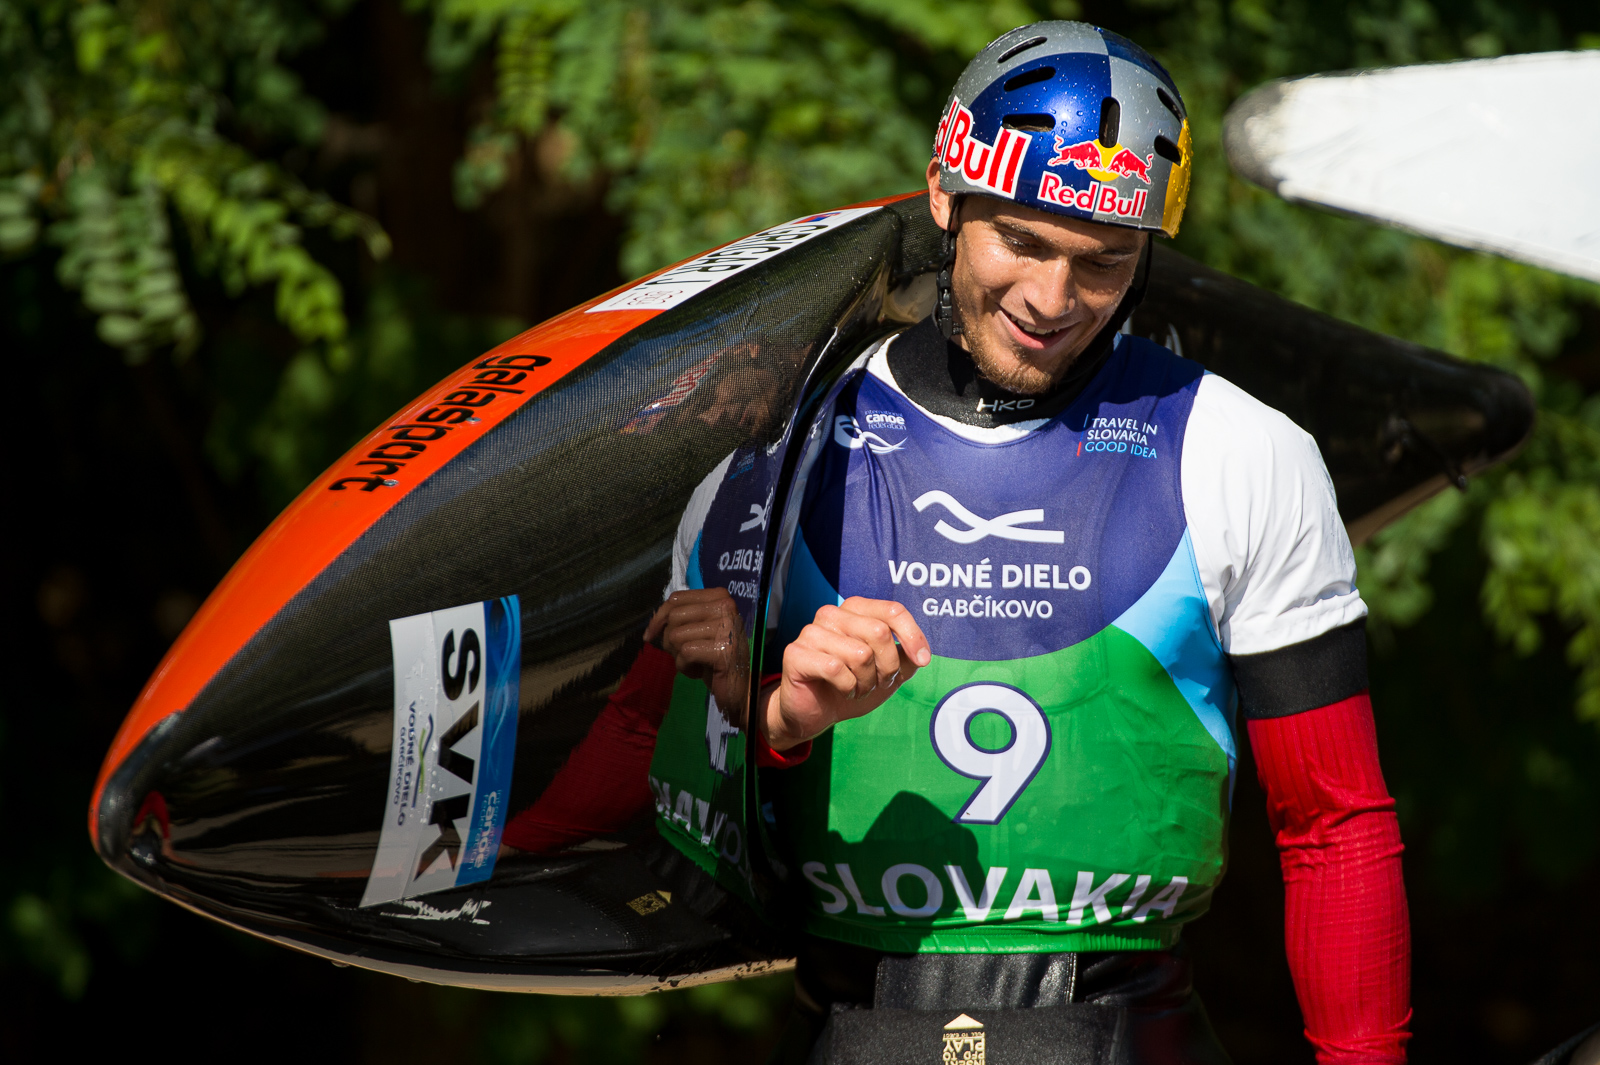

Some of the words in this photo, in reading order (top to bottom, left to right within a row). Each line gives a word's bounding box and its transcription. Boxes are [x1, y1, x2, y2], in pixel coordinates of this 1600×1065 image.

[944, 108, 1027, 195] Bull
[1039, 173, 1098, 210] Red
[1098, 187, 1148, 217] Bull
[662, 224, 829, 277] GRIGAR
[328, 354, 552, 492] galasport
[865, 413, 905, 425] canoe
[1086, 429, 1148, 445] SLOVAKIA
[1092, 417, 1138, 431] TRAVEL
[1142, 422, 1158, 435] IN
[1084, 440, 1128, 453] GOOD
[1130, 443, 1158, 459] IDEA
[888, 557, 993, 589] VODNÉ
[1001, 564, 1092, 591] DIELO
[922, 594, 1053, 619] GABČÍKOVO
[405, 700, 417, 766] VODNÉ
[413, 627, 481, 882] SVK
[929, 680, 1053, 825] 9
[398, 772, 412, 827] DIELO
[474, 791, 497, 868] canoe
[802, 860, 1189, 926] SLOVAKIA
[942, 1038, 986, 1054] PLAY
[942, 1051, 958, 1062] TO
[963, 1050, 986, 1061] PFD
